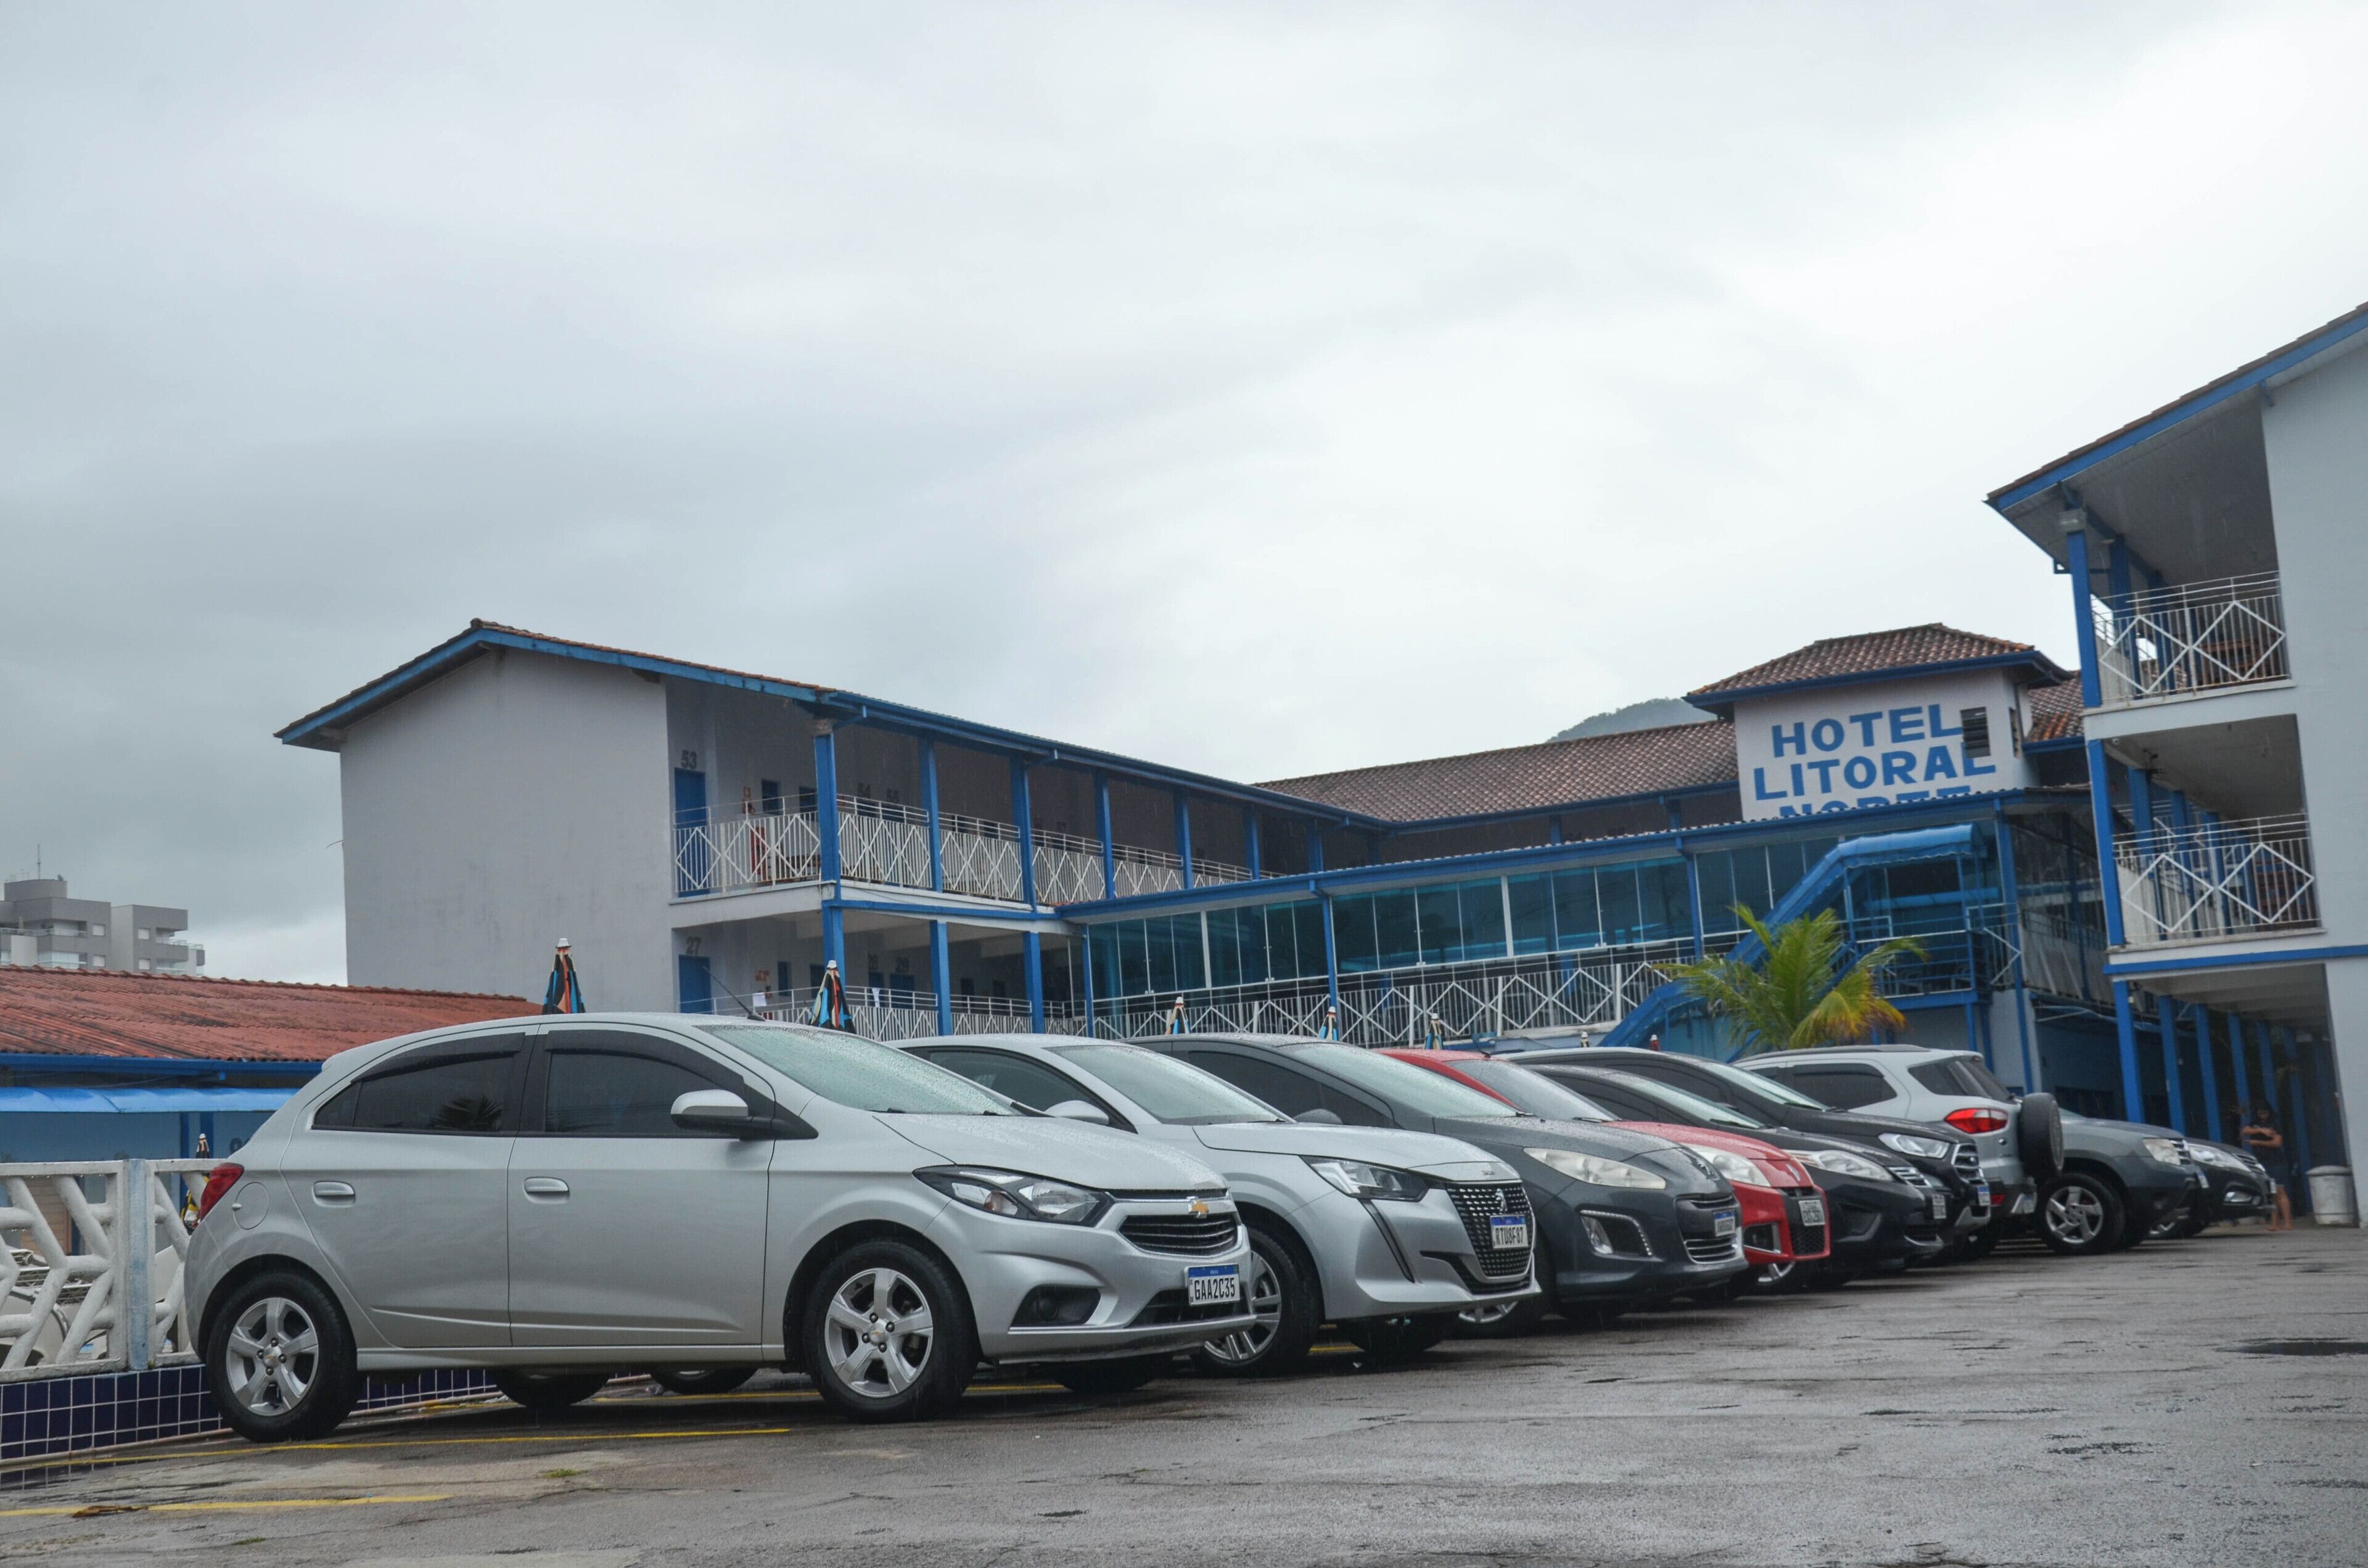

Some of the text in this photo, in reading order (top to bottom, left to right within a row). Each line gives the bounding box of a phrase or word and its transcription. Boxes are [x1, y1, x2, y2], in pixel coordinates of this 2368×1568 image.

[1771, 704, 1963, 758] HOTEL
[681, 750, 697, 770] 53
[1753, 742, 1996, 800] LITORAL
[686, 937, 702, 955] 27
[1194, 1278, 1235, 1300] GAA2C35
